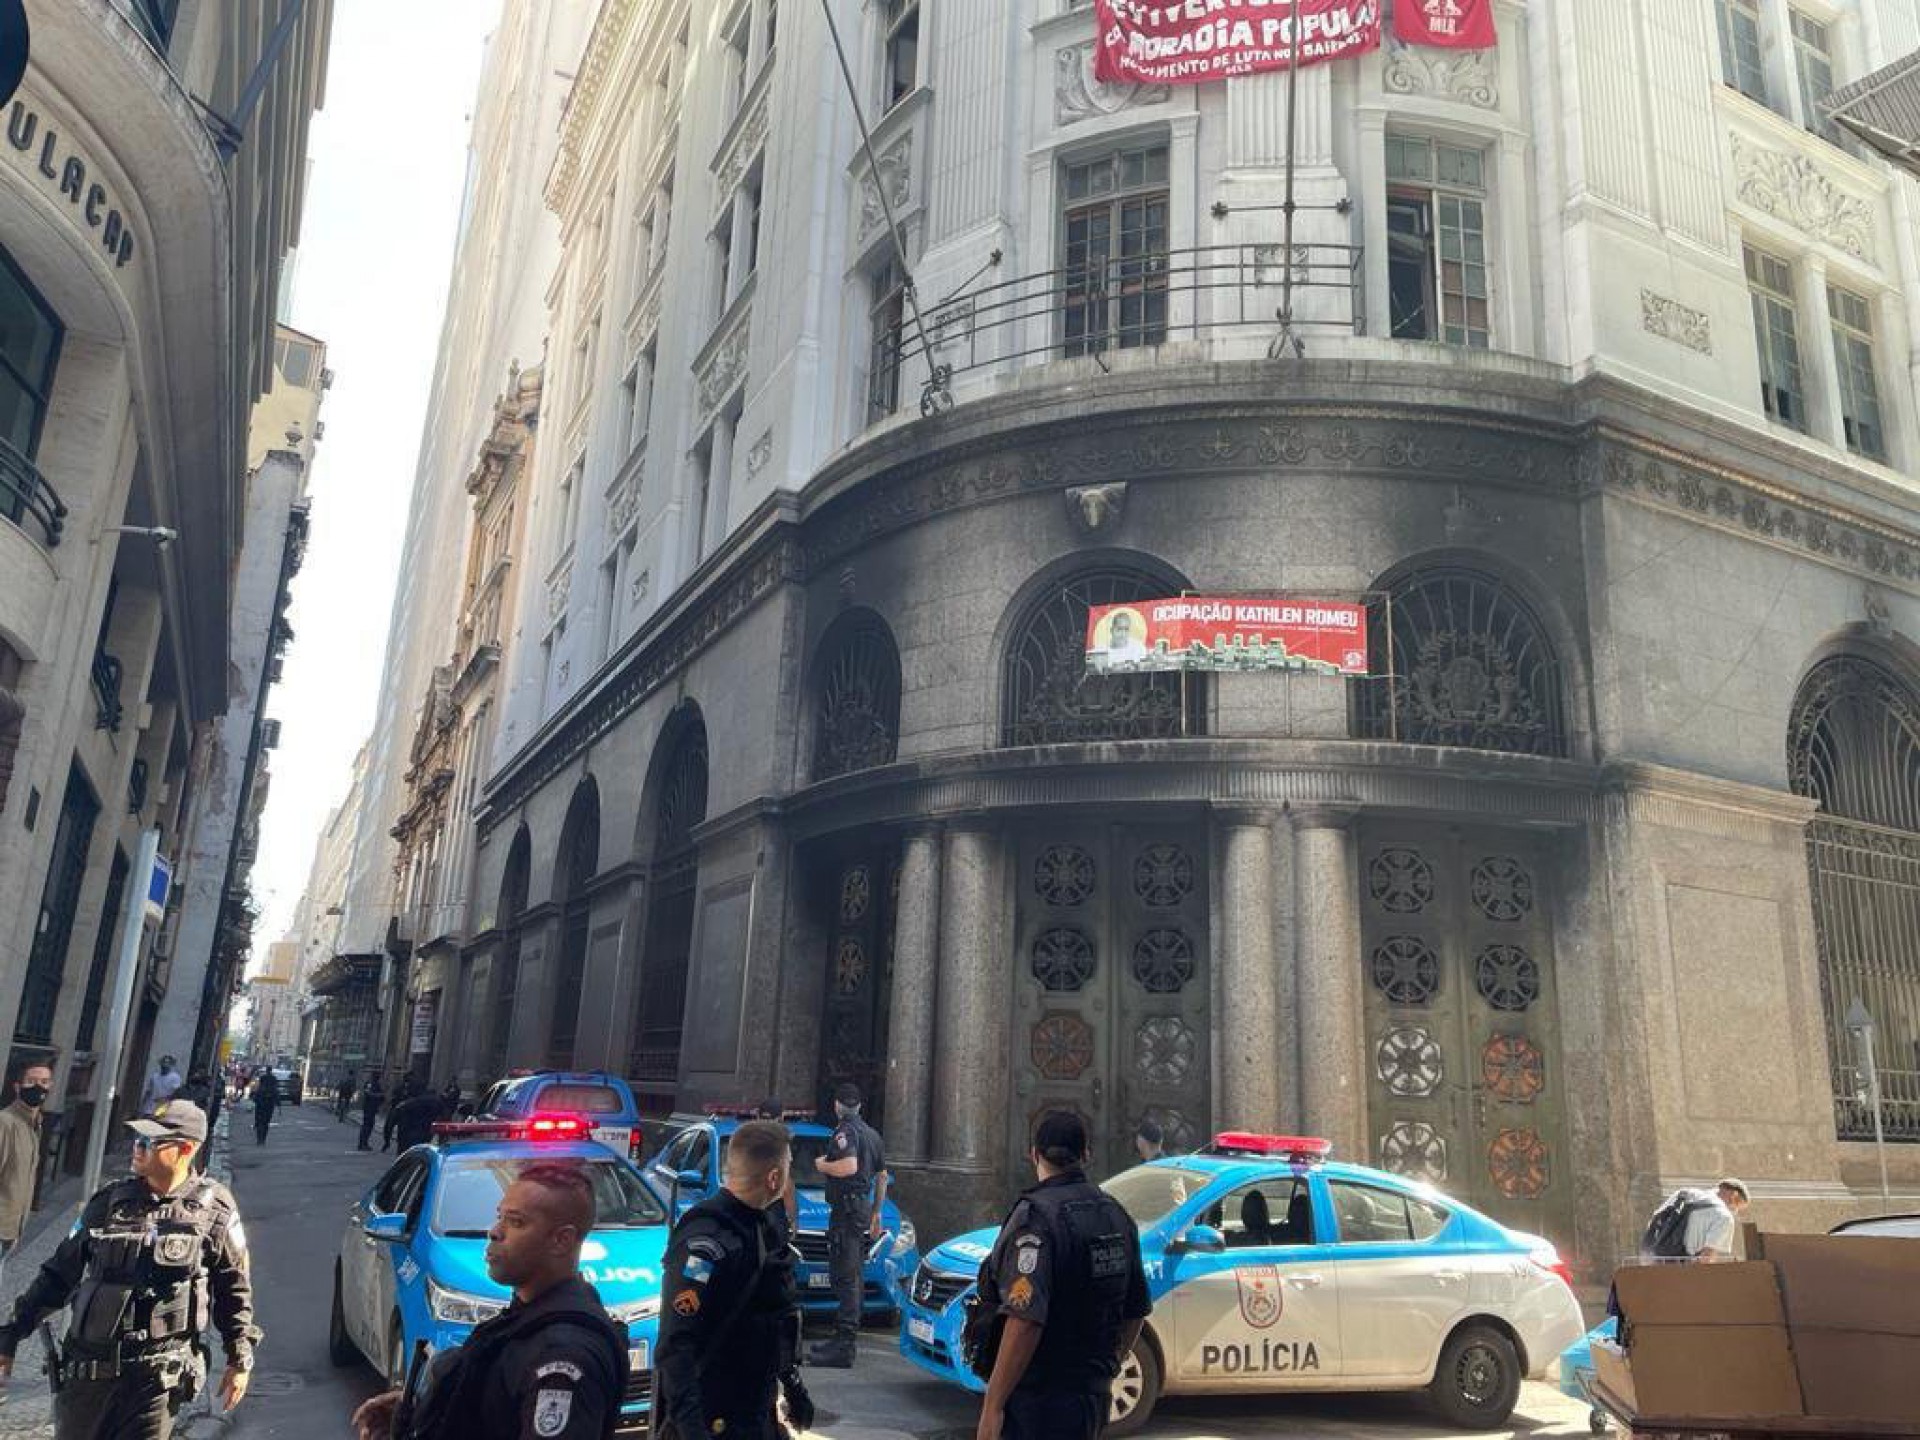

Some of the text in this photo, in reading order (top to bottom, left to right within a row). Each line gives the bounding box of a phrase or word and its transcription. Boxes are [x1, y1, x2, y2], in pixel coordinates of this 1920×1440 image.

[1213, 53, 1230, 68] DE
[1235, 50, 1270, 64] LUTA
[7, 100, 134, 268] ULACAP
[1153, 603, 1358, 627] OCUPAÇÃO KATHLEN ROMEU
[1202, 1337, 1320, 1374] POLÍCIA
